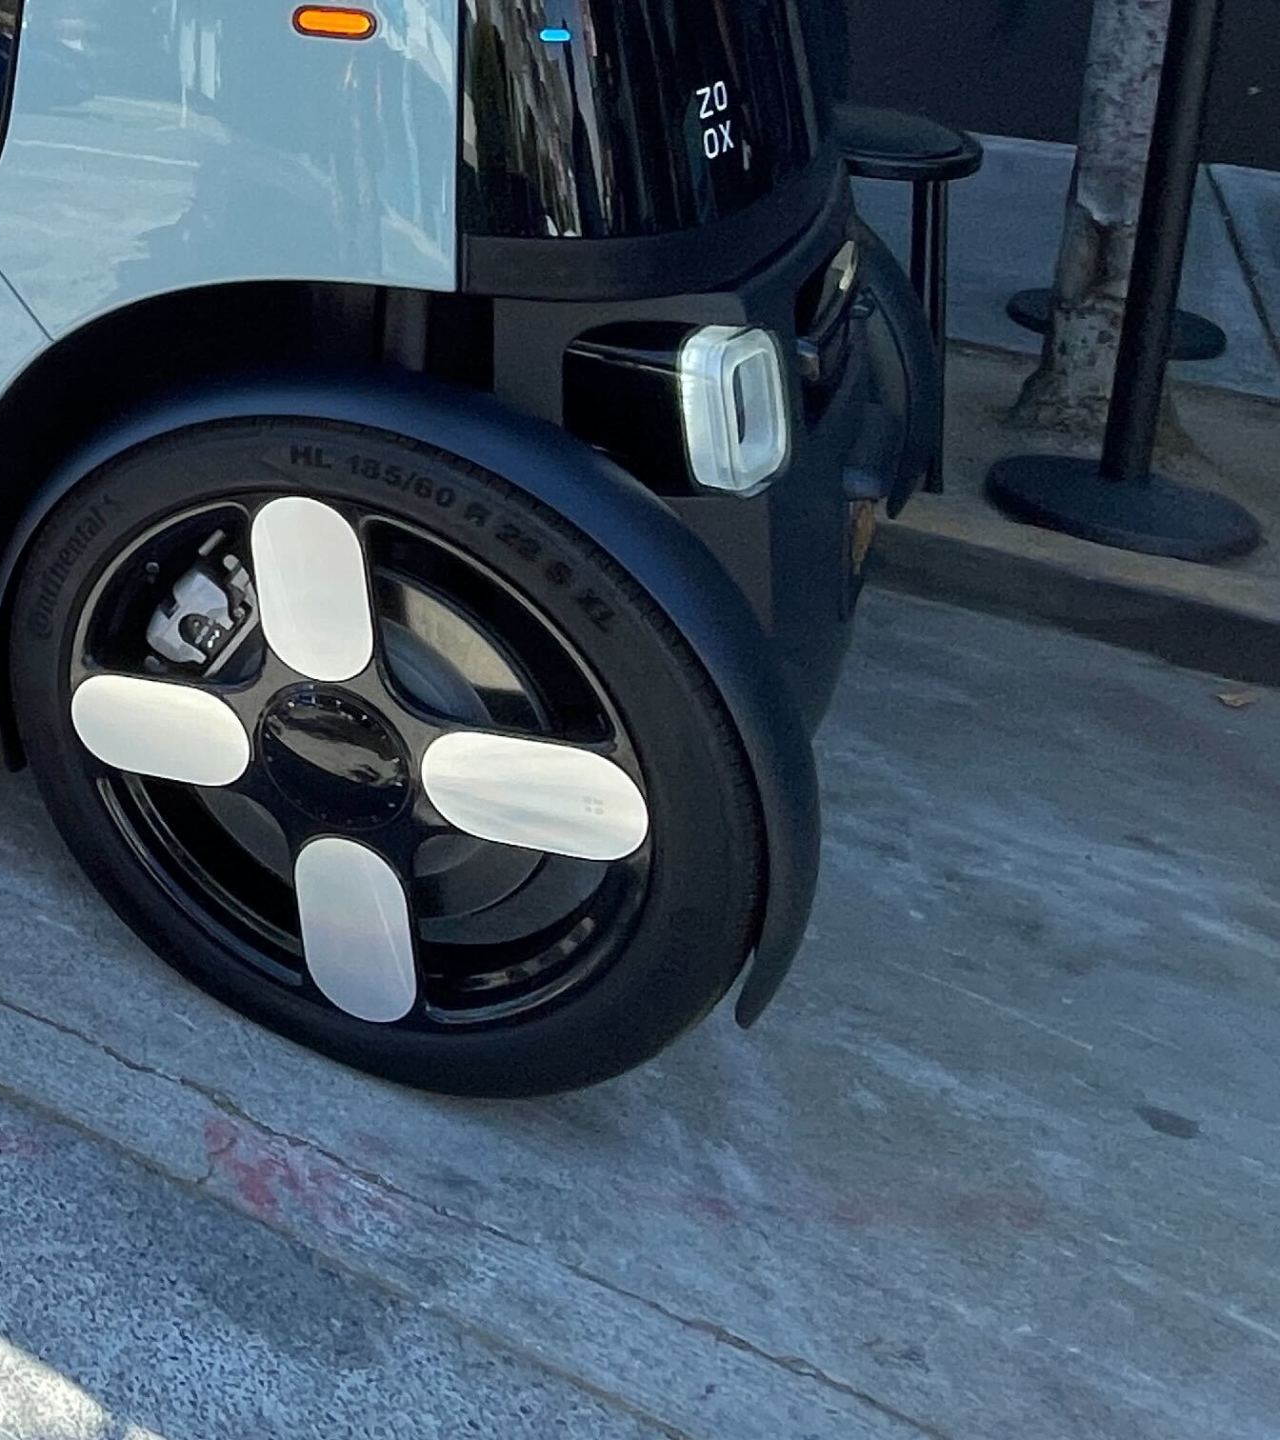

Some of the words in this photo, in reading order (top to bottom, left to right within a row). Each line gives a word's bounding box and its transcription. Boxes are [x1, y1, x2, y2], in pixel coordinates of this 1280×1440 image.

[695, 80, 729, 120] ZO
[703, 119, 735, 160] OX
[290, 445, 332, 471] HL
[346, 454, 458, 509] 185/60
